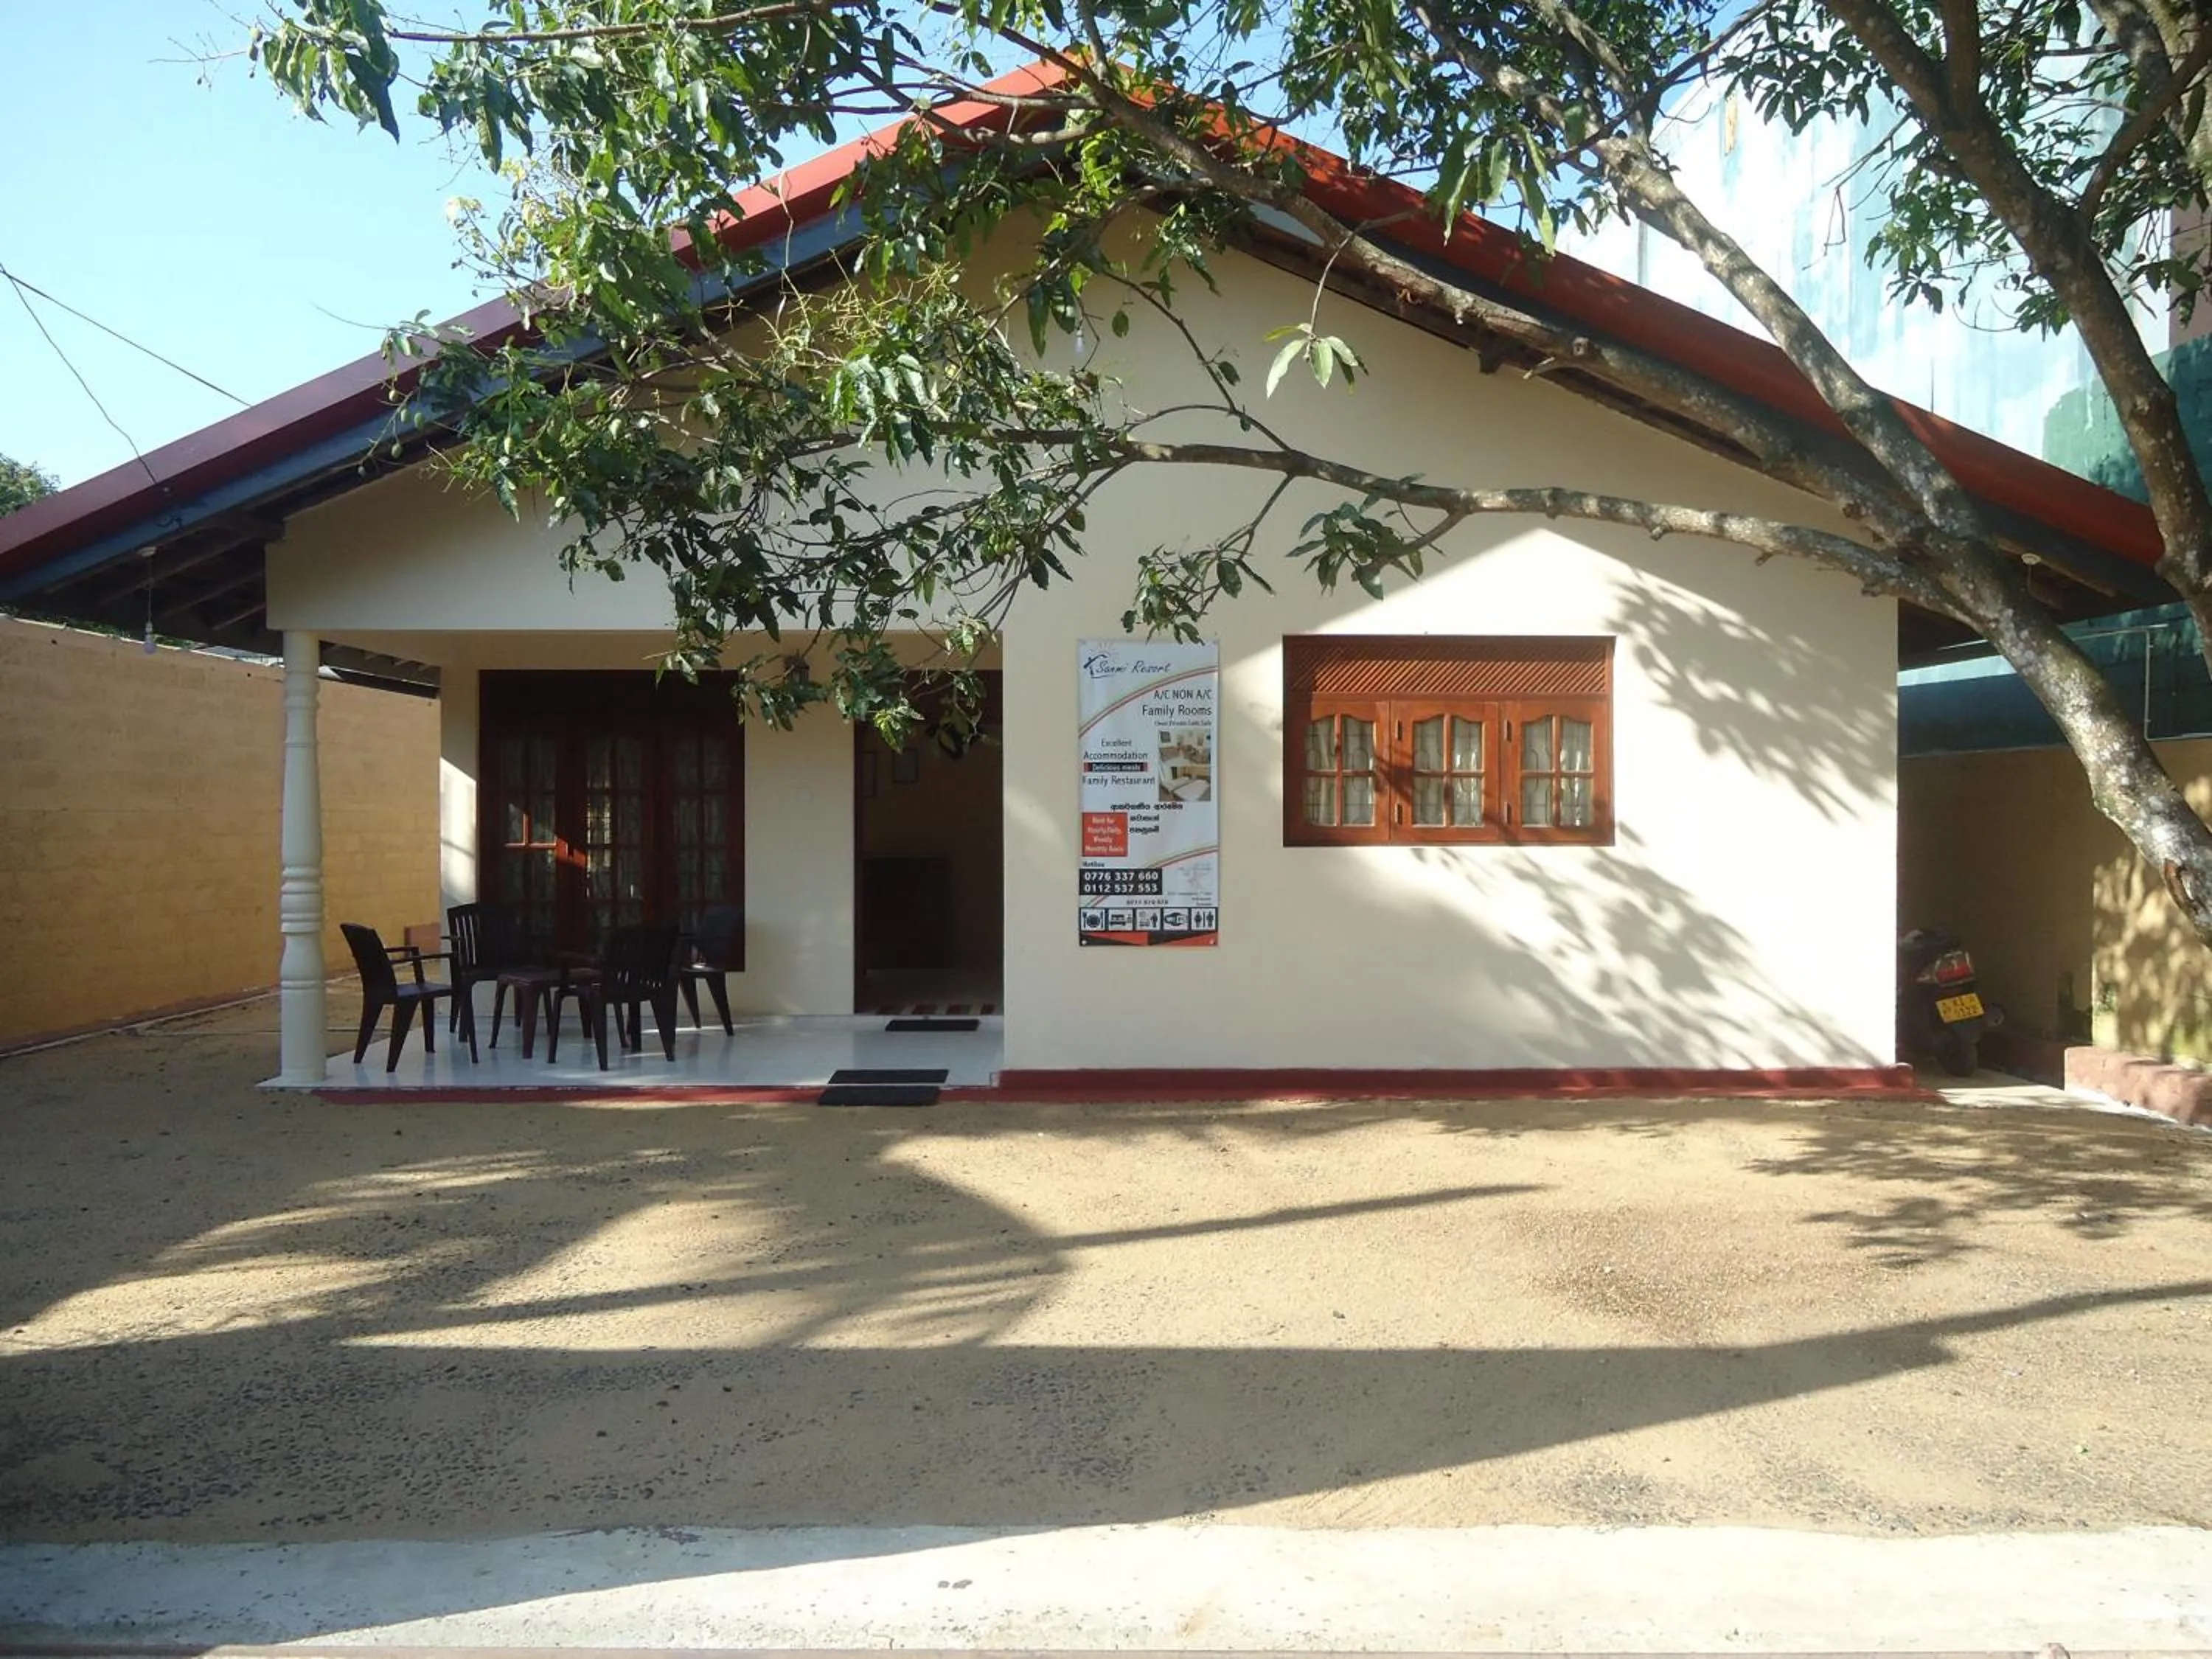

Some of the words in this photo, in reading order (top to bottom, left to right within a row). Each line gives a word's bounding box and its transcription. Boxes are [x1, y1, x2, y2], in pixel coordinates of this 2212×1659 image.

[1132, 660, 1171, 673] Resort
[1153, 689, 1170, 700] A/C
[1172, 689, 1193, 700] NON
[1196, 689, 1212, 700] A/C
[1142, 704, 1175, 717] Family
[1178, 704, 1212, 716] Rooms
[1101, 738, 1132, 747] Excellent
[1083, 751, 1148, 760] Accommodation
[1082, 775, 1108, 787] Family
[1111, 775, 1155, 785] Restaurant
[1084, 872, 1111, 880] 0776
[1115, 872, 1135, 880] 337
[1138, 872, 1158, 880] 660
[1084, 884, 1111, 893] 0112
[1115, 884, 1135, 893] 537
